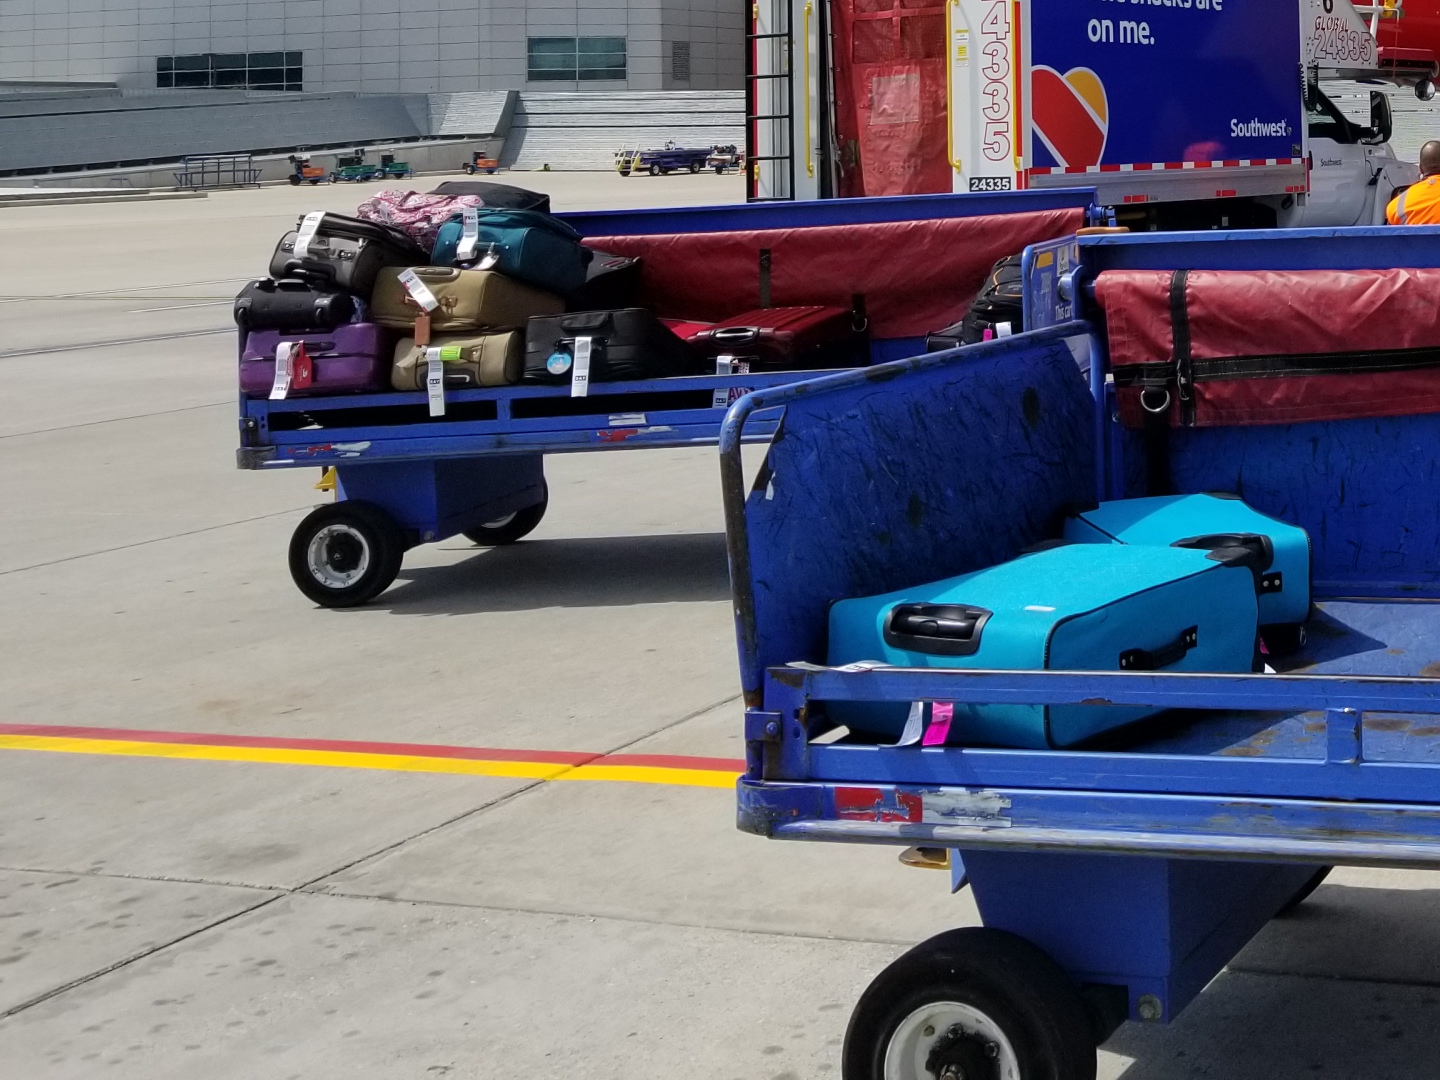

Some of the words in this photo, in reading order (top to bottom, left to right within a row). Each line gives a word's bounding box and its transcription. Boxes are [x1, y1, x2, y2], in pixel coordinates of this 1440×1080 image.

[1087, 18, 1114, 43] on
[1119, 20, 1155, 45] me.
[1314, 15, 1350, 32] GLOBAL
[1313, 30, 1372, 62] 24335
[1230, 117, 1286, 137] Southwest
[970, 178, 1010, 191] 24335
